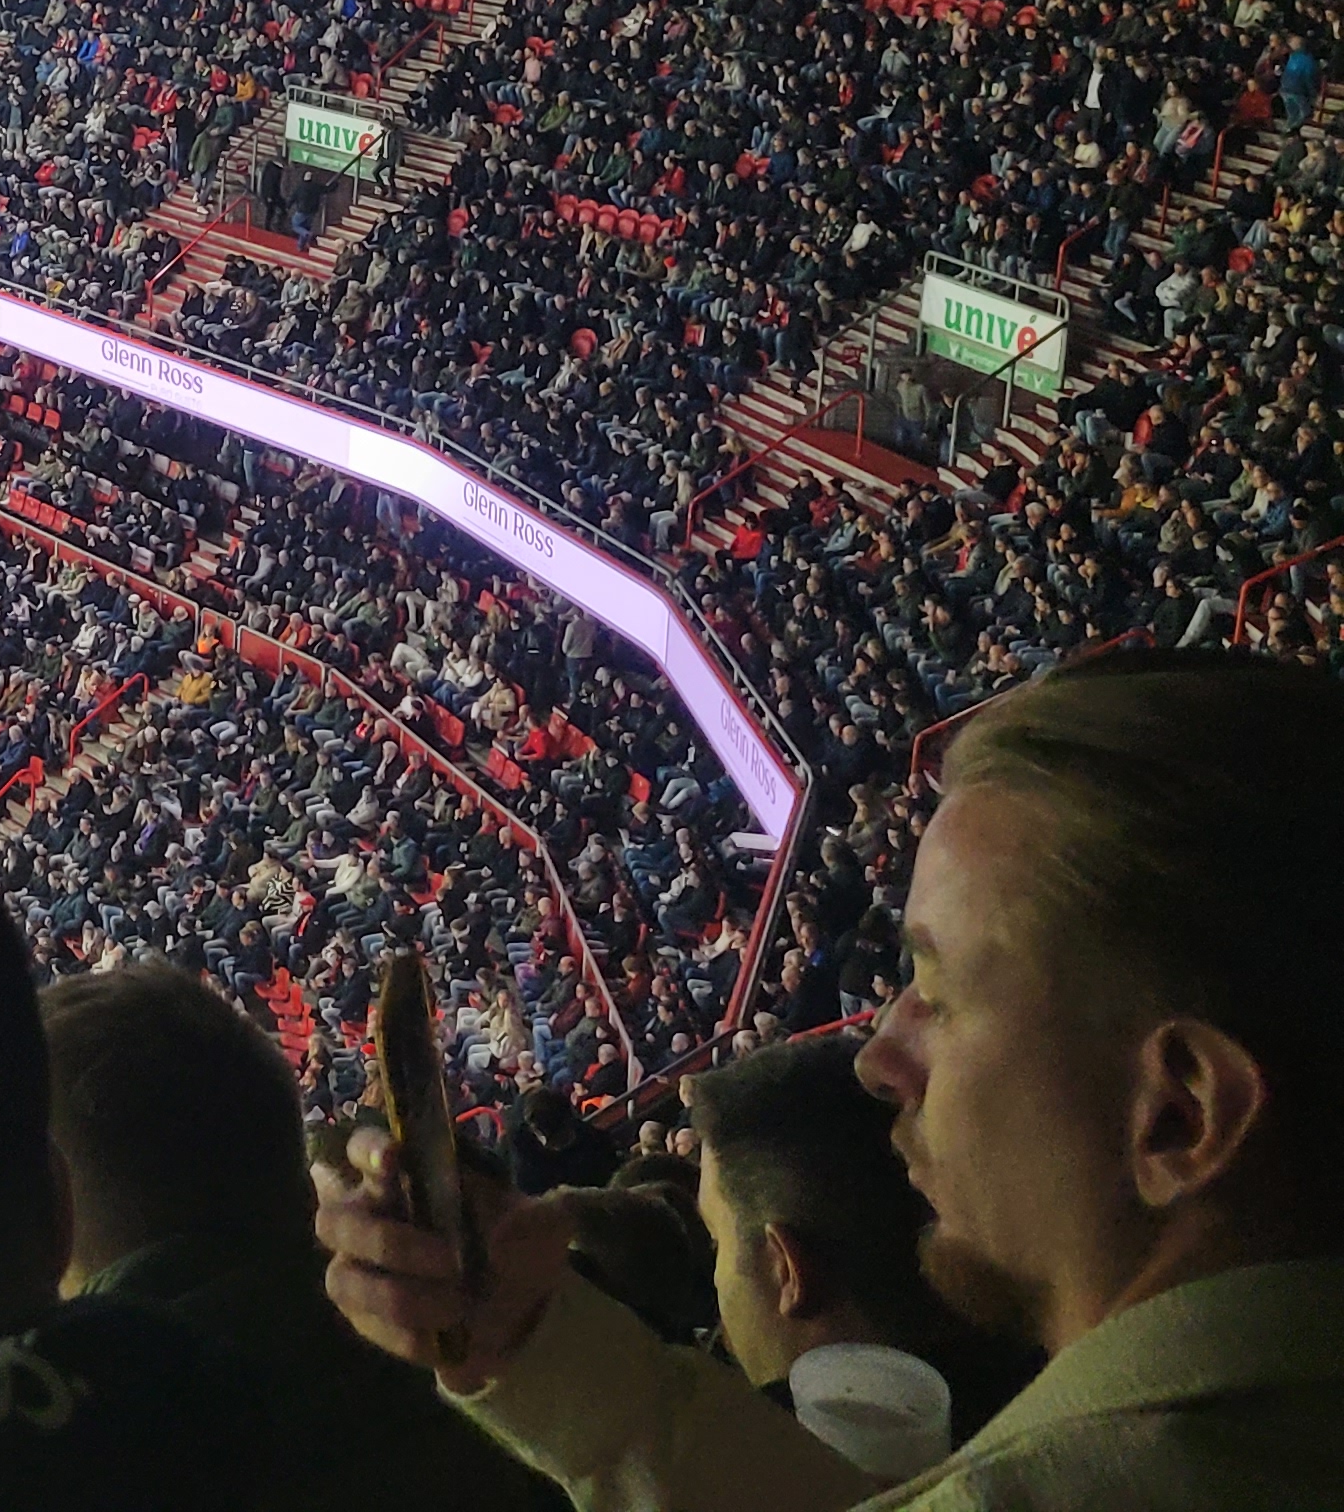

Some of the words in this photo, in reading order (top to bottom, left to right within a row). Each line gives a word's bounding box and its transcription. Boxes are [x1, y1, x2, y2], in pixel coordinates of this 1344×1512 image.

[298, 117, 375, 156] univé
[945, 297, 1037, 359] univé
[101, 339, 153, 376] Glenn
[158, 363, 203, 394] Ross
[462, 483, 510, 533] Glenn
[512, 508, 555, 559] Ross
[719, 698, 752, 761] Glenn
[751, 745, 778, 806] Ross
